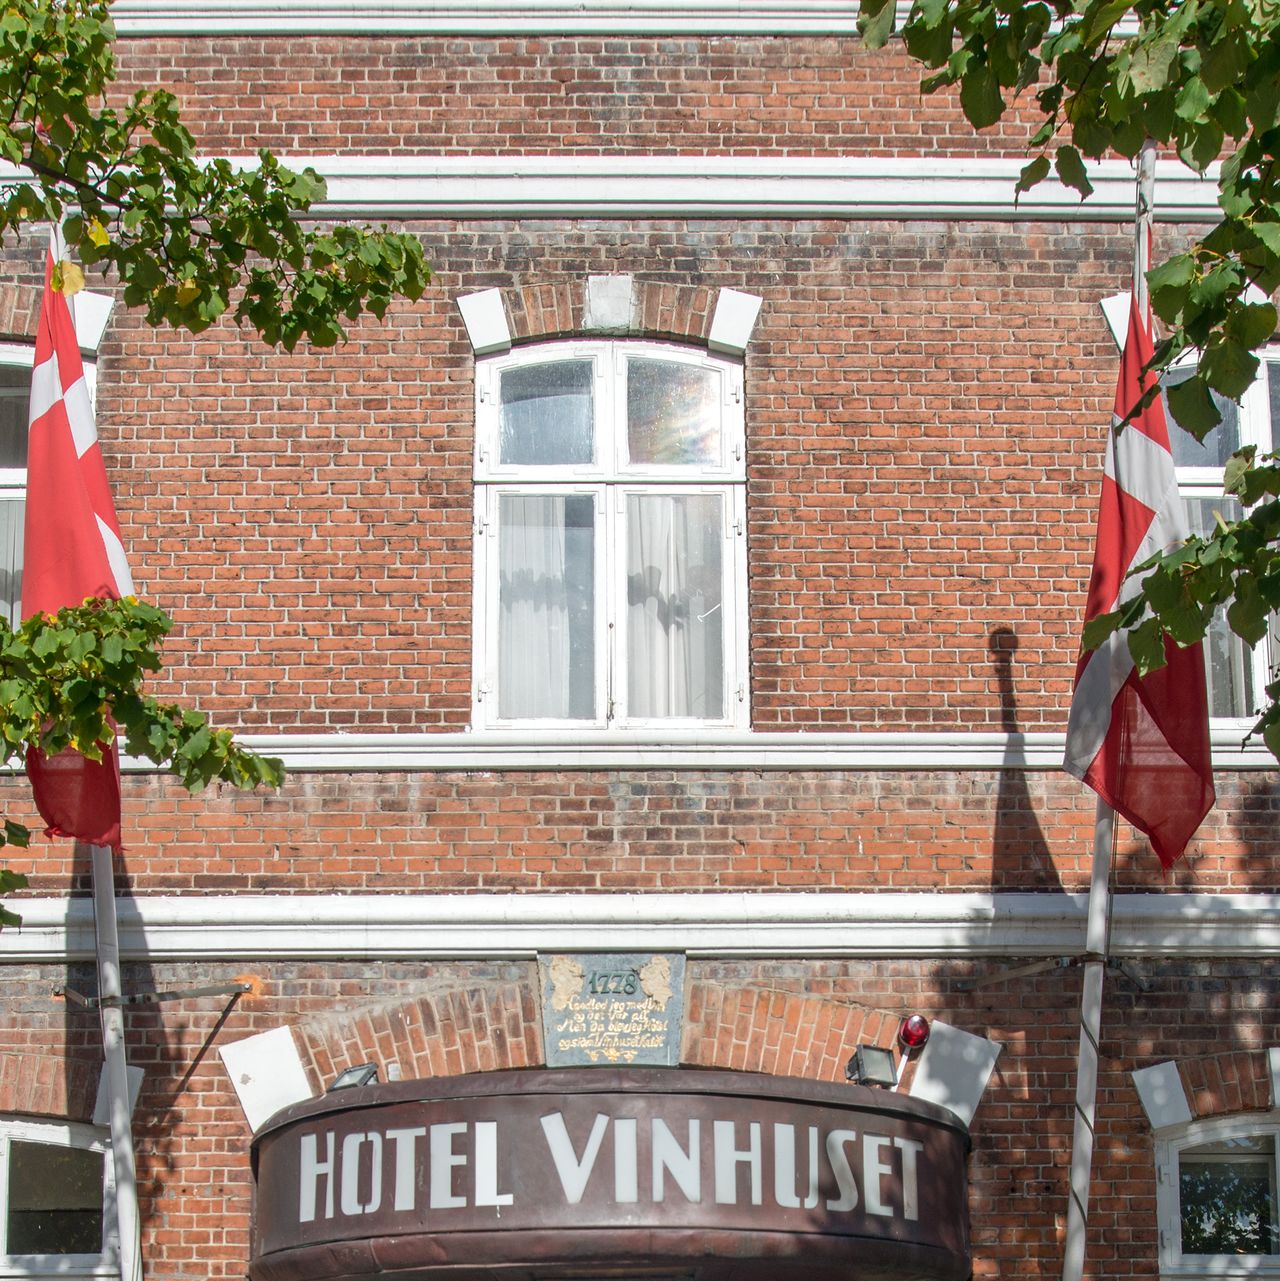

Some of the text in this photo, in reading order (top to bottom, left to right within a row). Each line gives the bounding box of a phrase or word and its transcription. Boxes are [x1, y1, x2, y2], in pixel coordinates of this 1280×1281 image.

[588, 971, 636, 994] 1778
[299, 1110, 924, 1223] HOTEL VINHUSET
